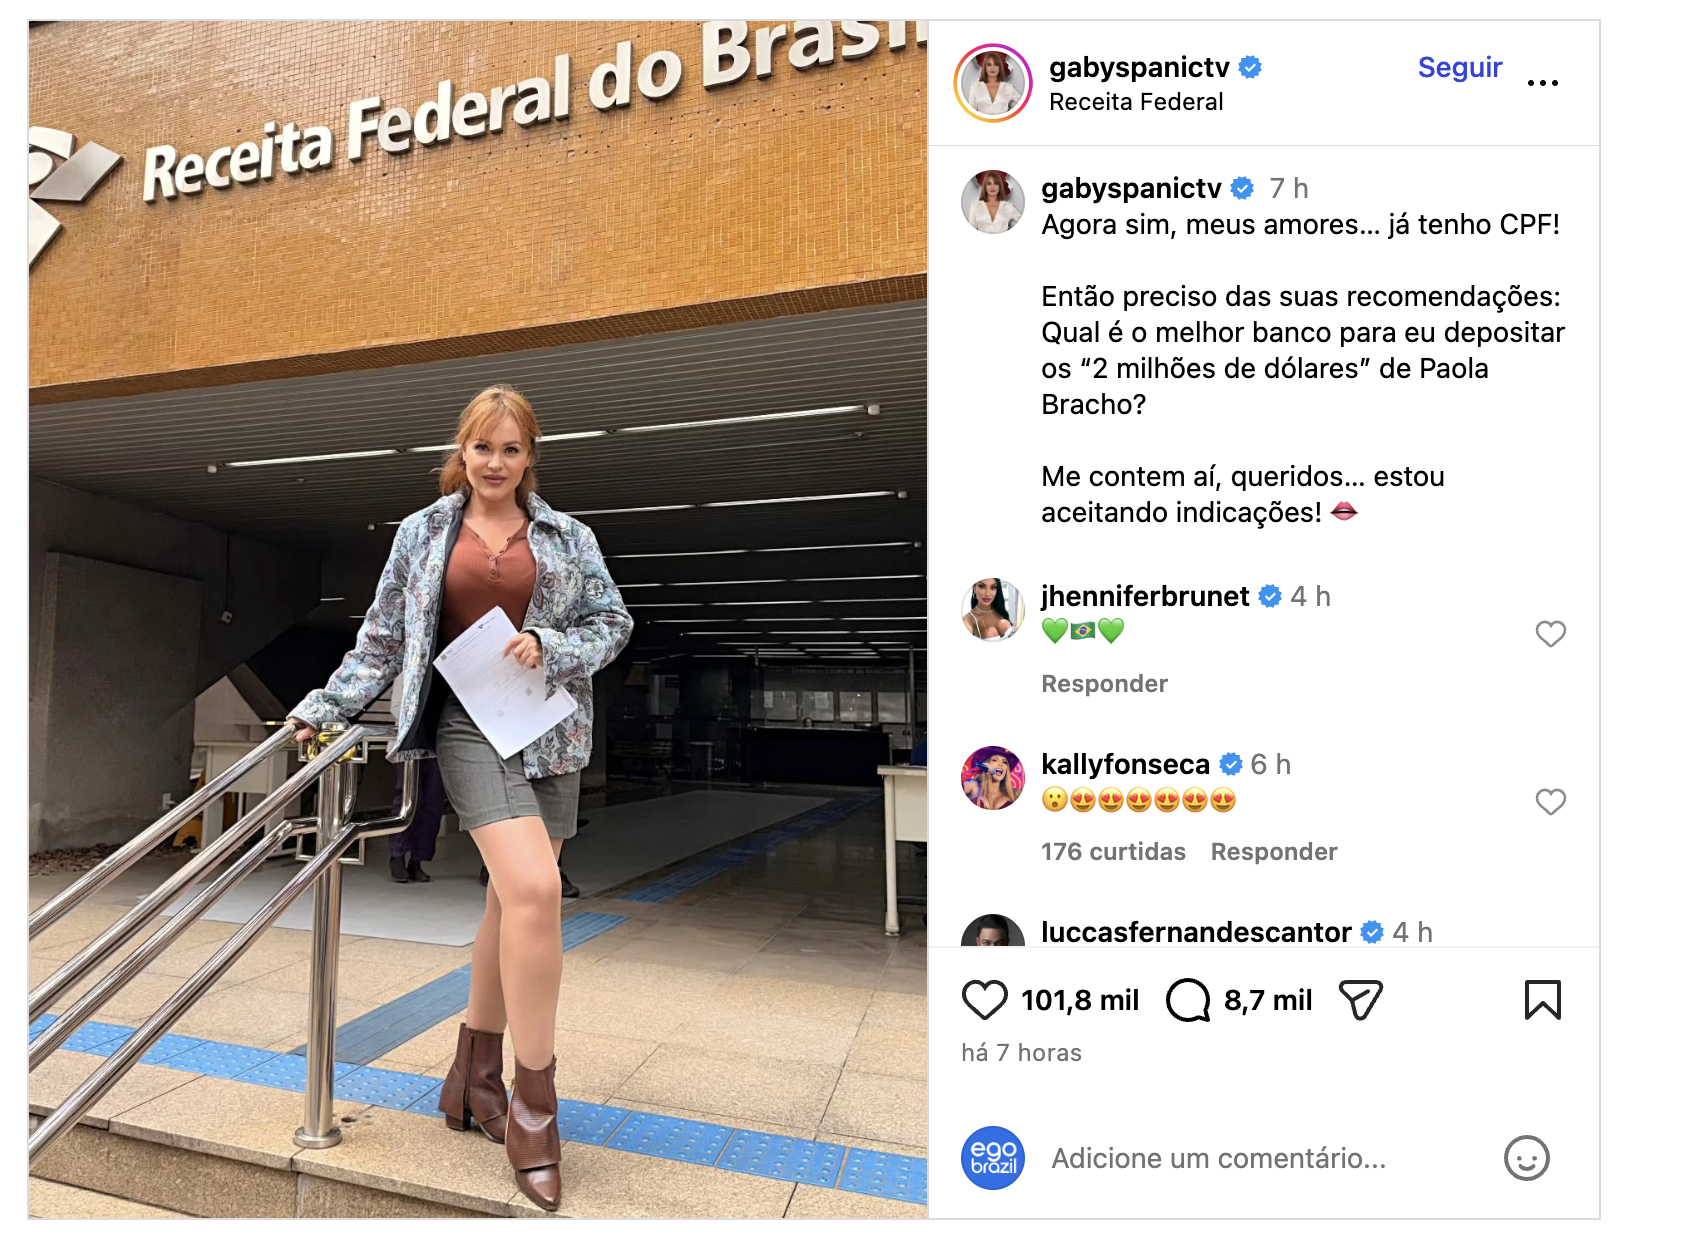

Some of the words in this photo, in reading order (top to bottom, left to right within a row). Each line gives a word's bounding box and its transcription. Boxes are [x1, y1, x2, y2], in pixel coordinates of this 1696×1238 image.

[142, 120, 334, 204] Receita
[347, 51, 571, 163] Federal
[588, 40, 683, 112] do
[702, 20, 928, 93] Bras
